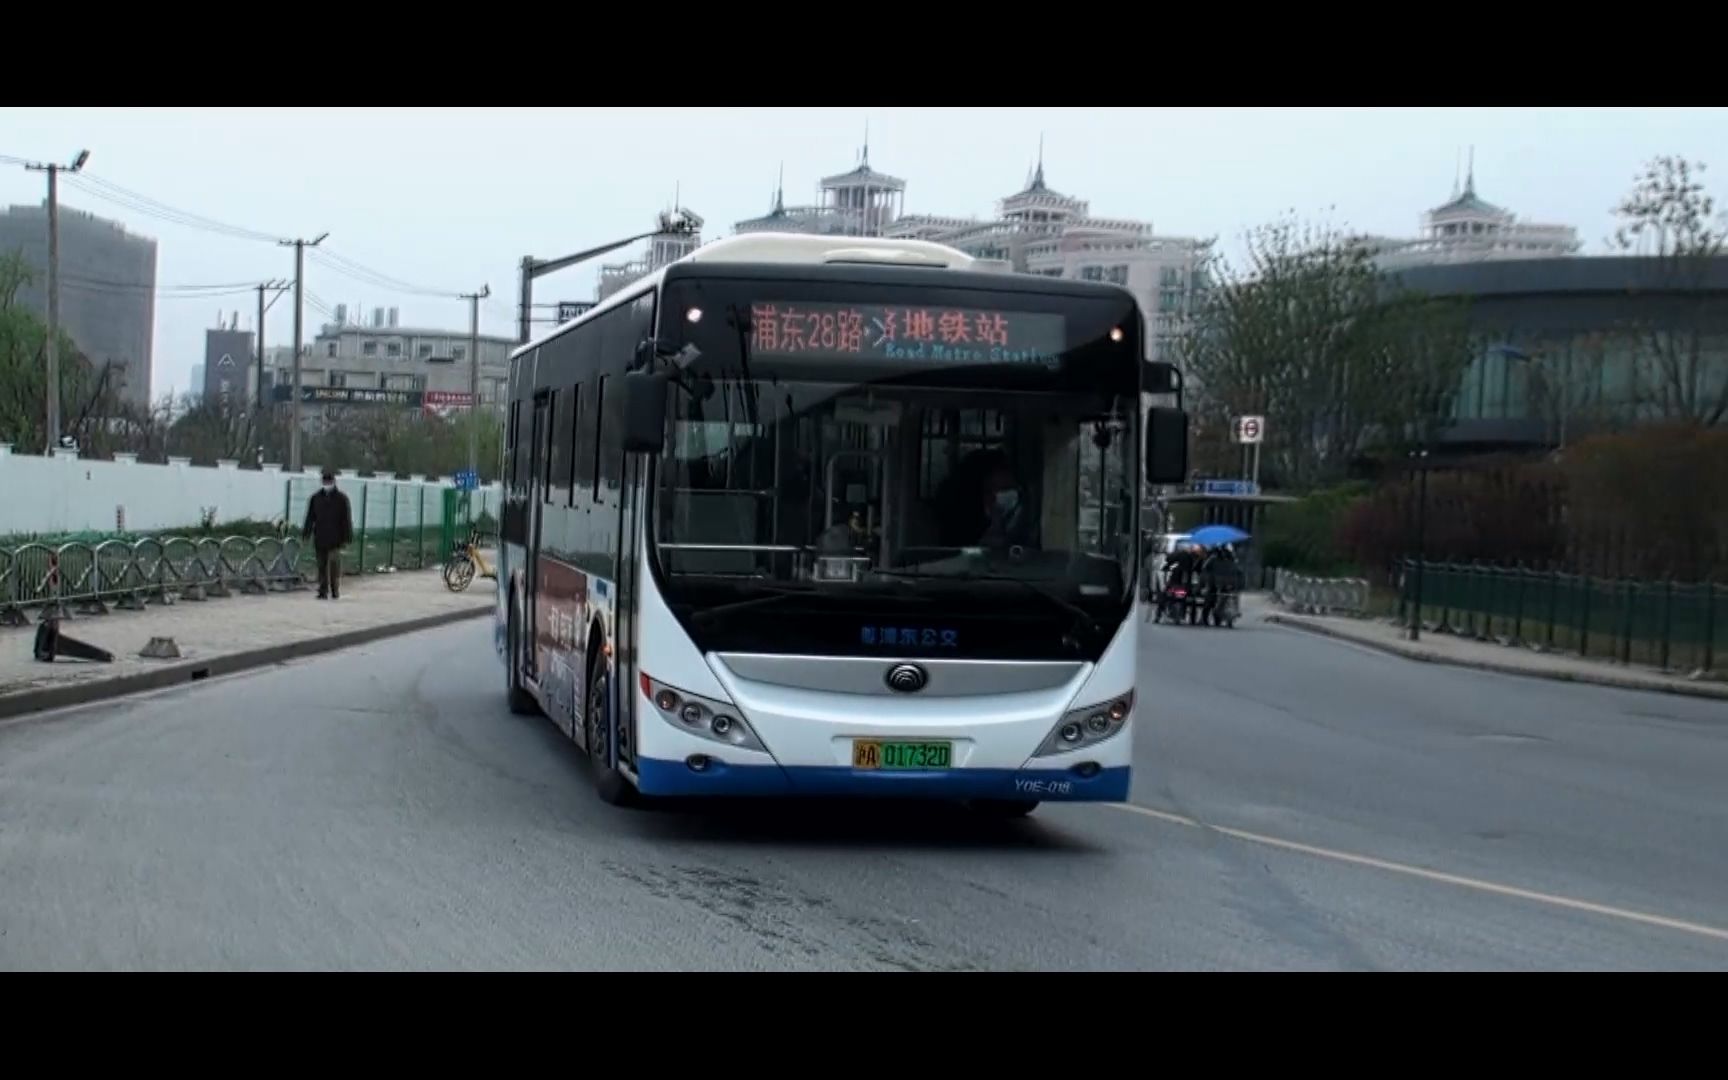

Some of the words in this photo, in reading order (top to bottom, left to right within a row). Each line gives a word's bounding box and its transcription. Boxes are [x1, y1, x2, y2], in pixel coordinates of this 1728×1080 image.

[752, 304, 864, 352] 浦东28路
[886, 342, 925, 359] Road
[931, 344, 983, 361] Metro
